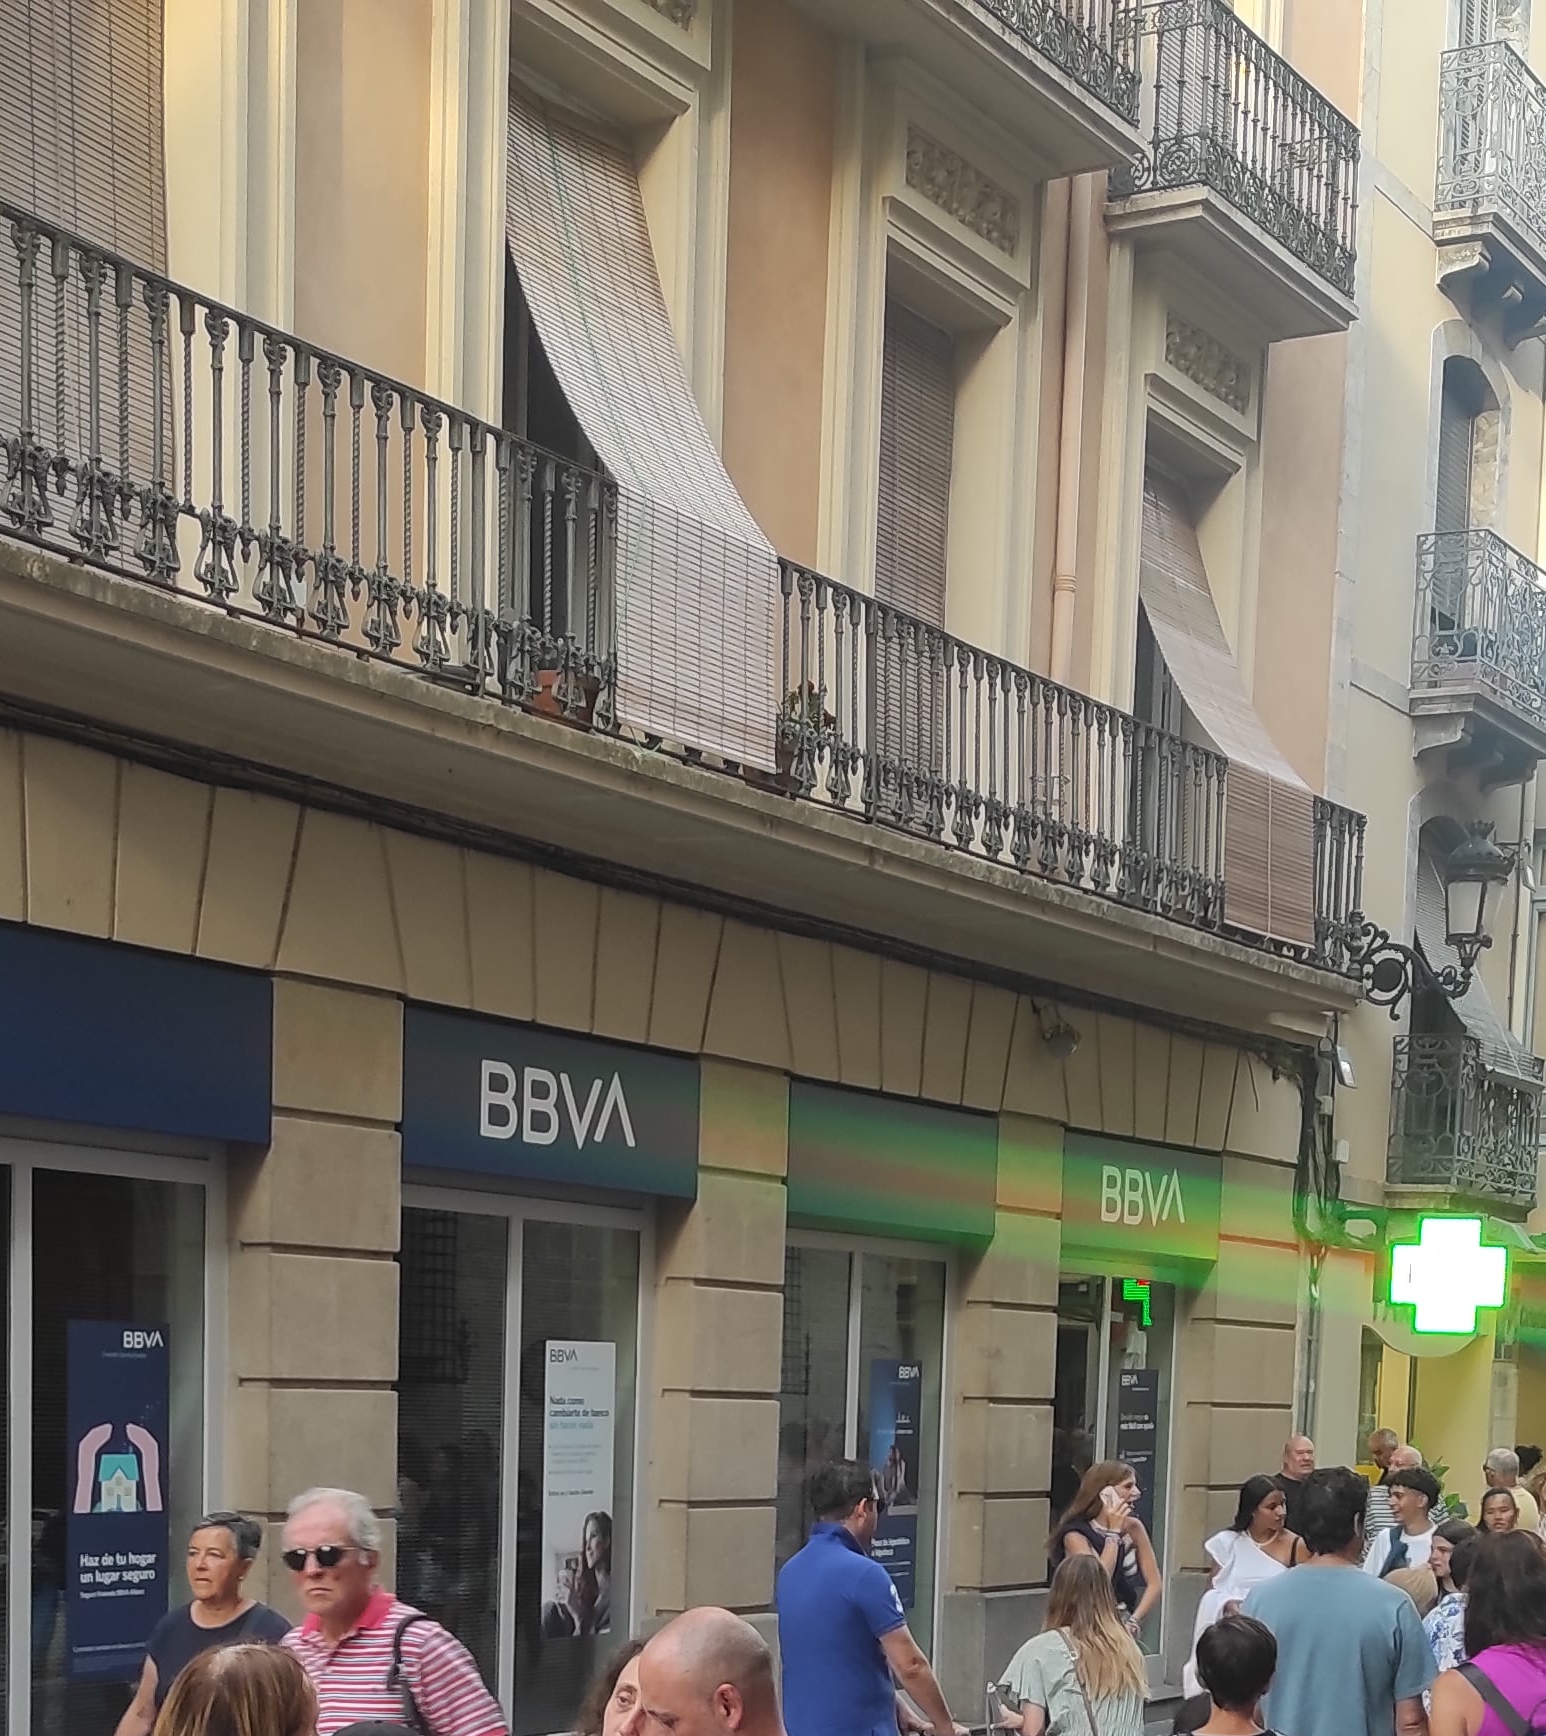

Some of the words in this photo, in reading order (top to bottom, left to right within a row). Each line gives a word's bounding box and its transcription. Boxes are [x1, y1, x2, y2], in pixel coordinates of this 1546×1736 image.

[478, 1057, 637, 1151] BBVA
[1099, 1164, 1186, 1227] BBVA
[122, 1329, 165, 1349] BBVA
[549, 1348, 579, 1363] BBVA
[79, 1553, 100, 1568] Haz
[101, 1552, 114, 1567] de
[115, 1552, 127, 1566] tu
[128, 1551, 157, 1567] hogar
[79, 1572, 94, 1584] un
[95, 1569, 120, 1585] lugar
[121, 1569, 156, 1584] seguro
